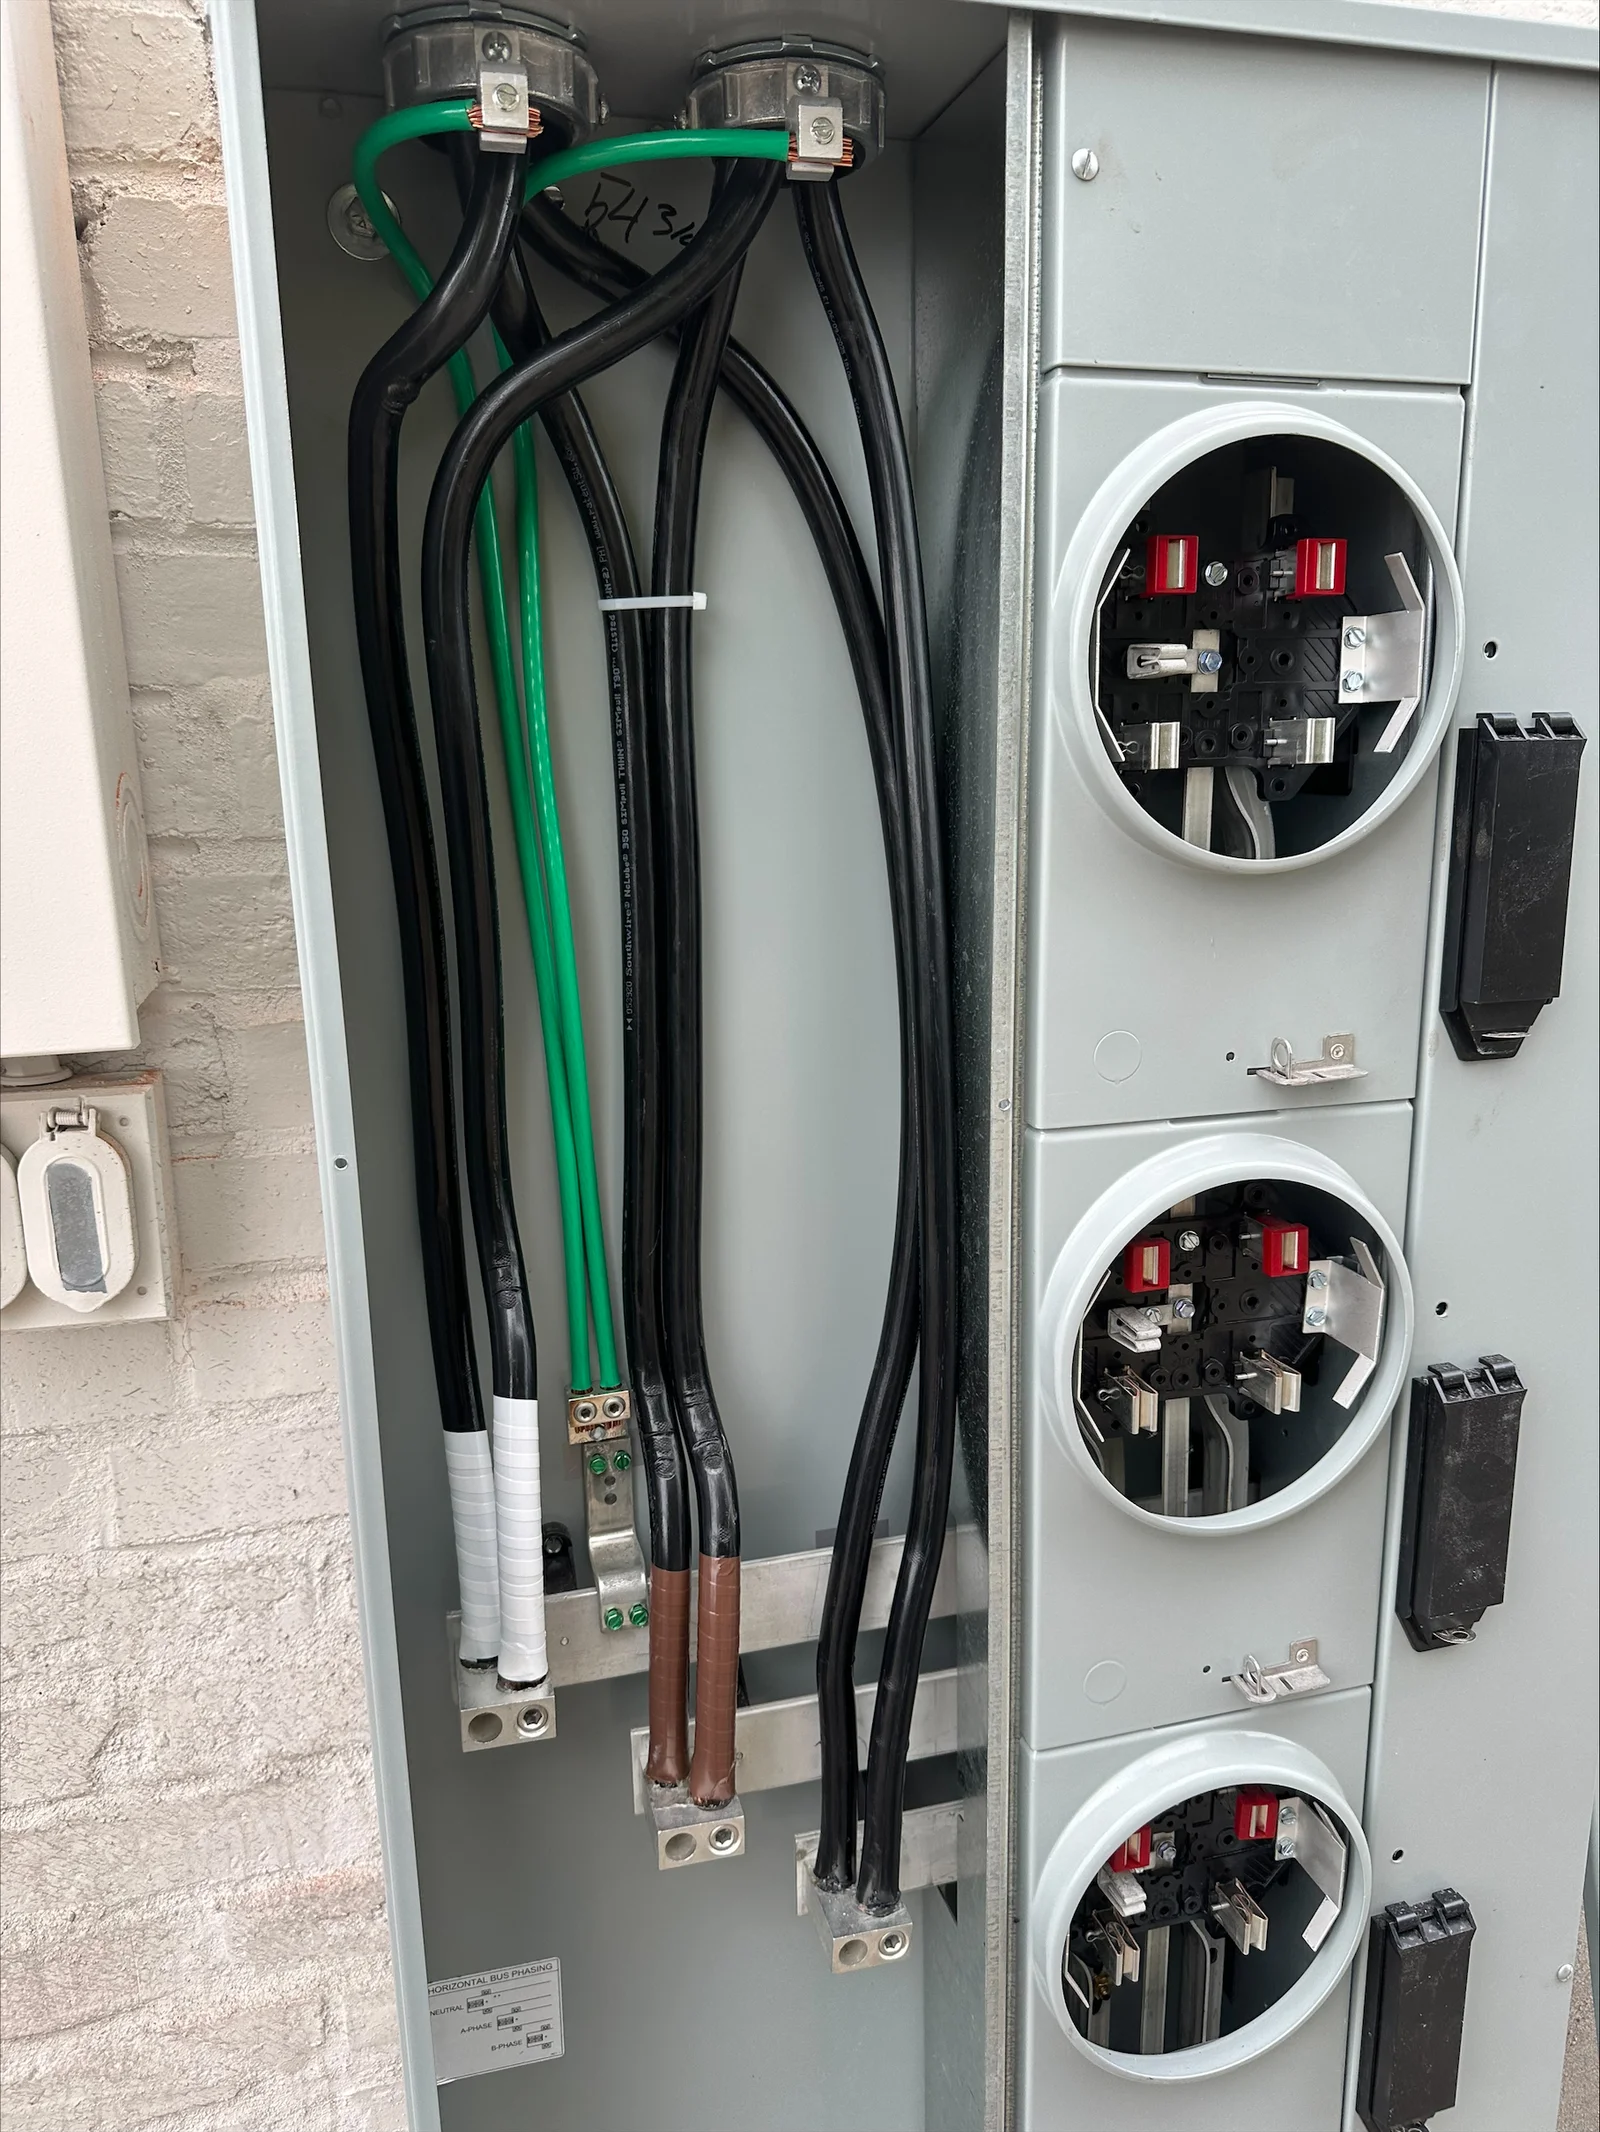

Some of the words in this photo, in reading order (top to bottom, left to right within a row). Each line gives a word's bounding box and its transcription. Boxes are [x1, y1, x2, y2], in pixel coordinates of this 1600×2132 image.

[428, 1977, 488, 1995] HORIZONTAL
[490, 1972, 510, 1982] BUS
[511, 1962, 553, 1977] PHASING
[429, 2005, 464, 2017] NEUTRAL
[460, 2022, 493, 2034] A-PHASE
[491, 2039, 523, 2052] B-PHASE
